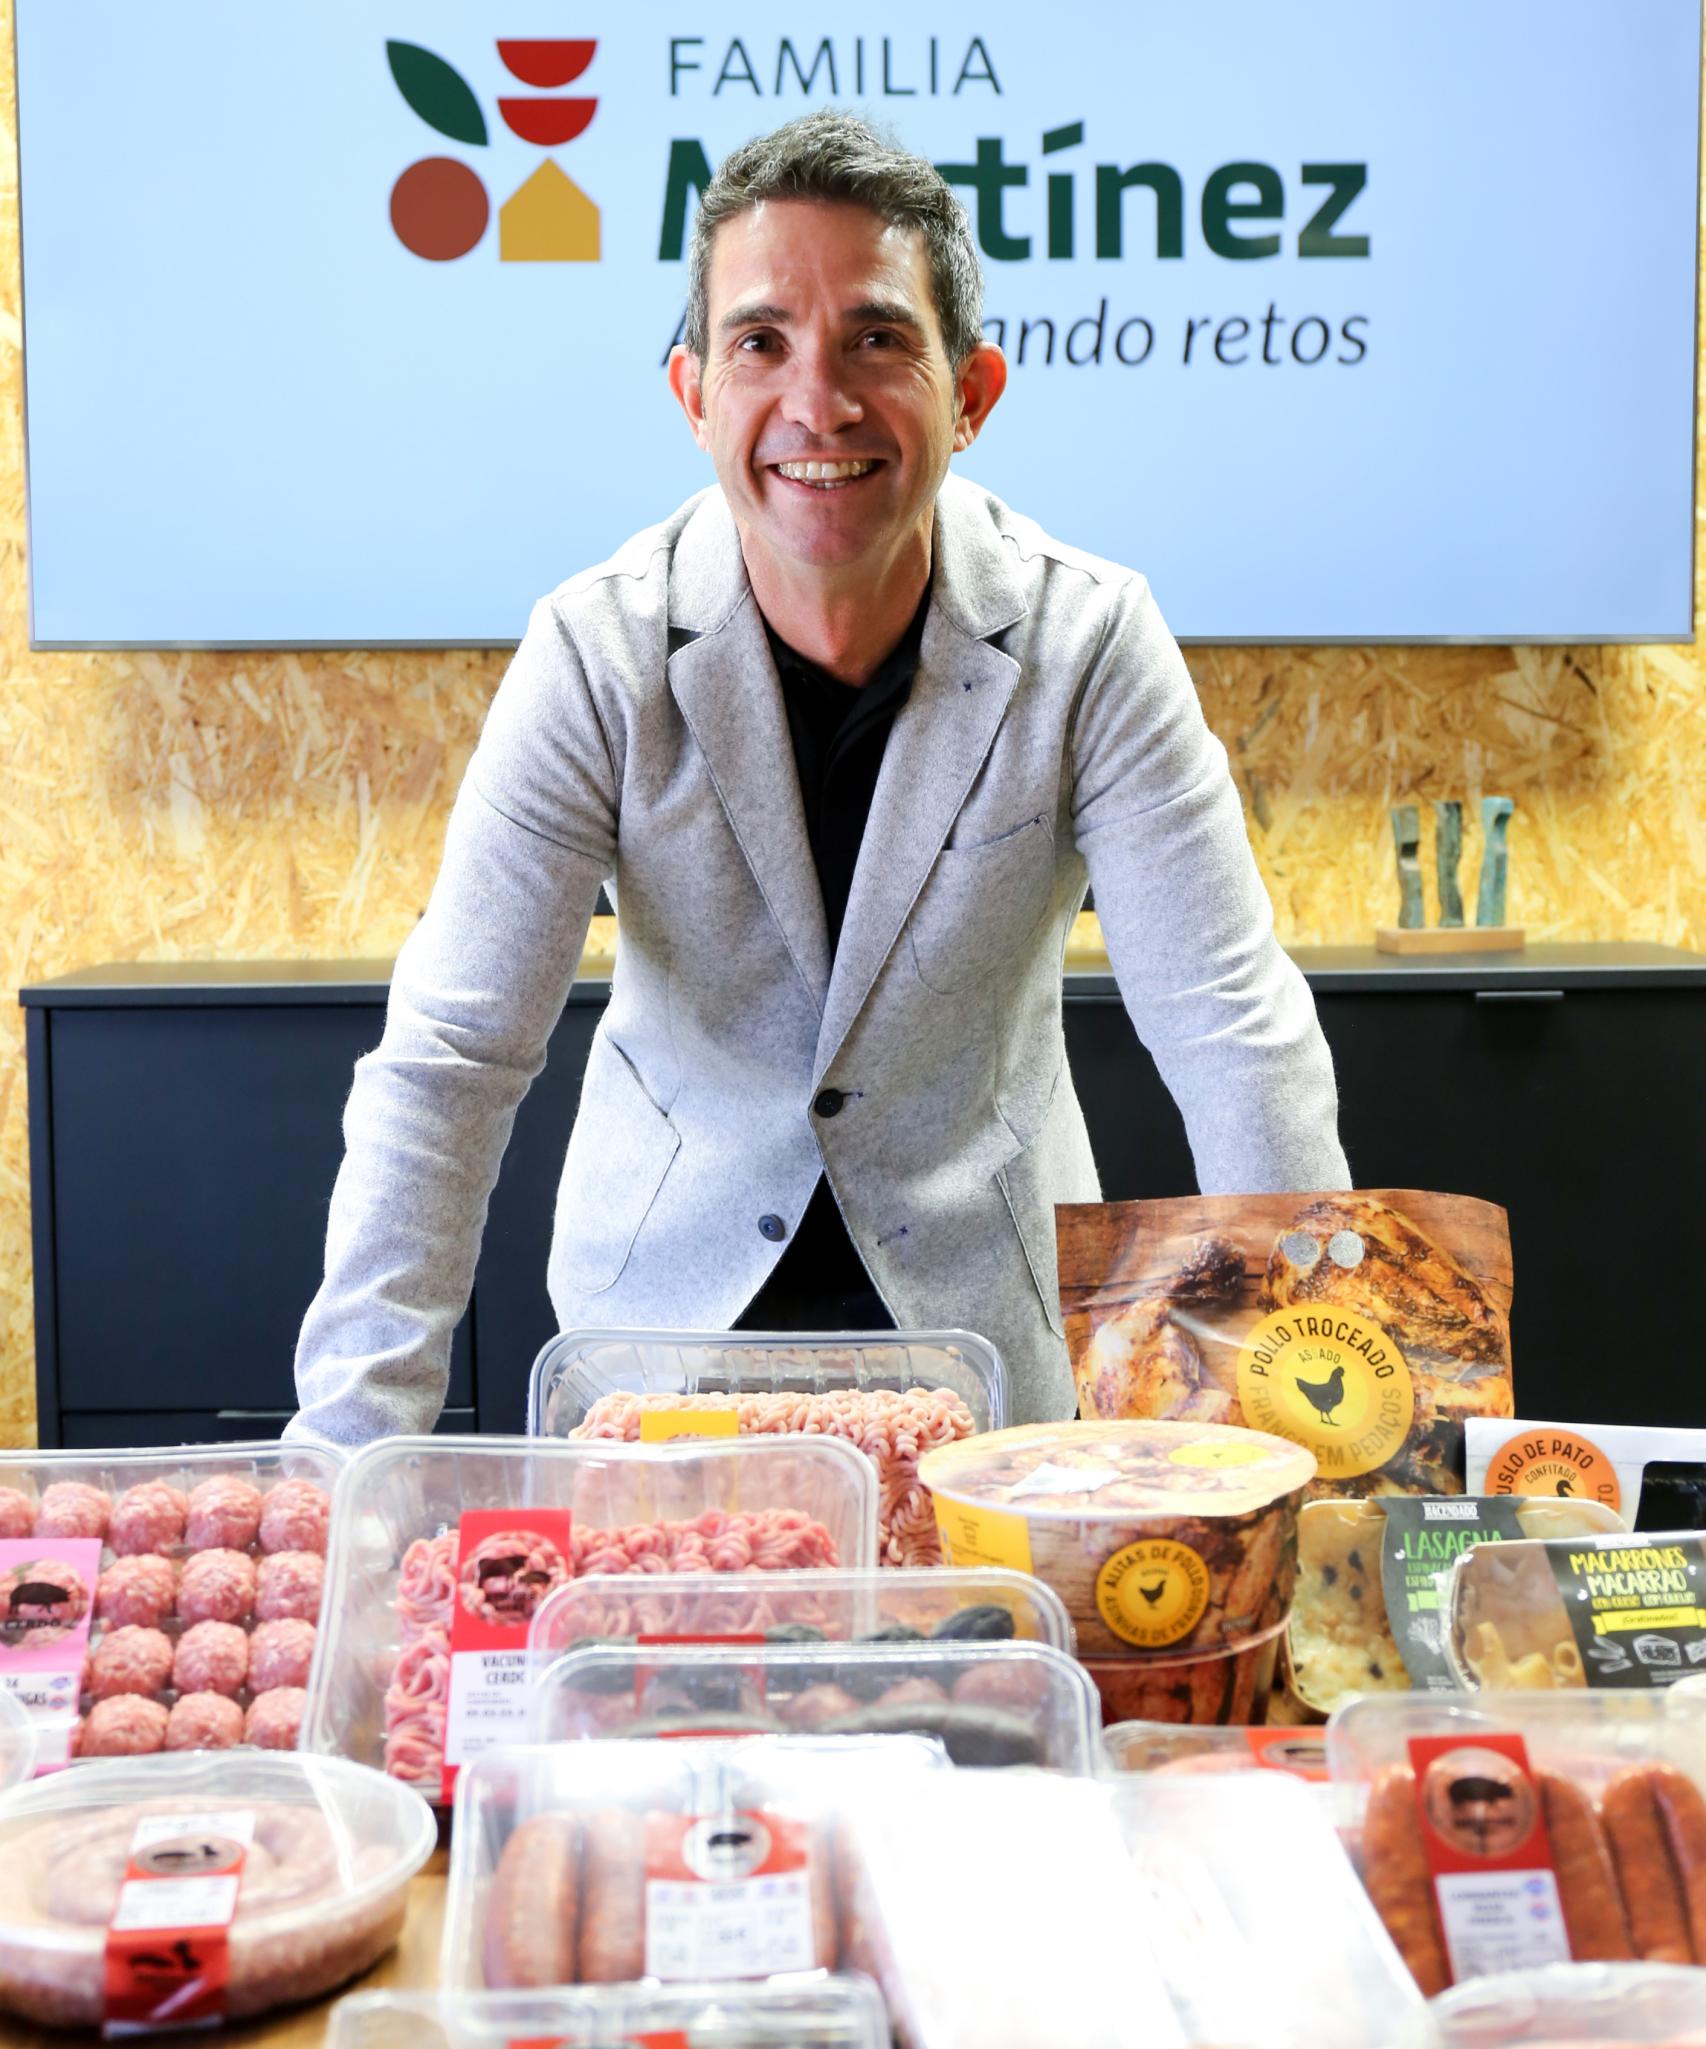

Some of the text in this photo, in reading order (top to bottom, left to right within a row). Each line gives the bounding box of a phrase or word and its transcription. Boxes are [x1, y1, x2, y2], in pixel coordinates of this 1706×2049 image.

[669, 36, 1004, 97] FAMILIA
[658, 121, 1371, 262] tínez
[1182, 302, 1371, 367] retos
[1249, 1316, 1395, 1380] POLLO TROCEADO
[1349, 1387, 1402, 1462] PEDAÇOS
[1495, 1438, 1594, 1495] USLO DE PATO
[1524, 1463, 1578, 1485] CONFITADO
[1105, 1549, 1146, 1588] ALITAS
[1151, 1546, 1170, 1559] DE
[1568, 1545, 1689, 1576] MACARRONES
[482, 1655, 527, 1668] VACUN
